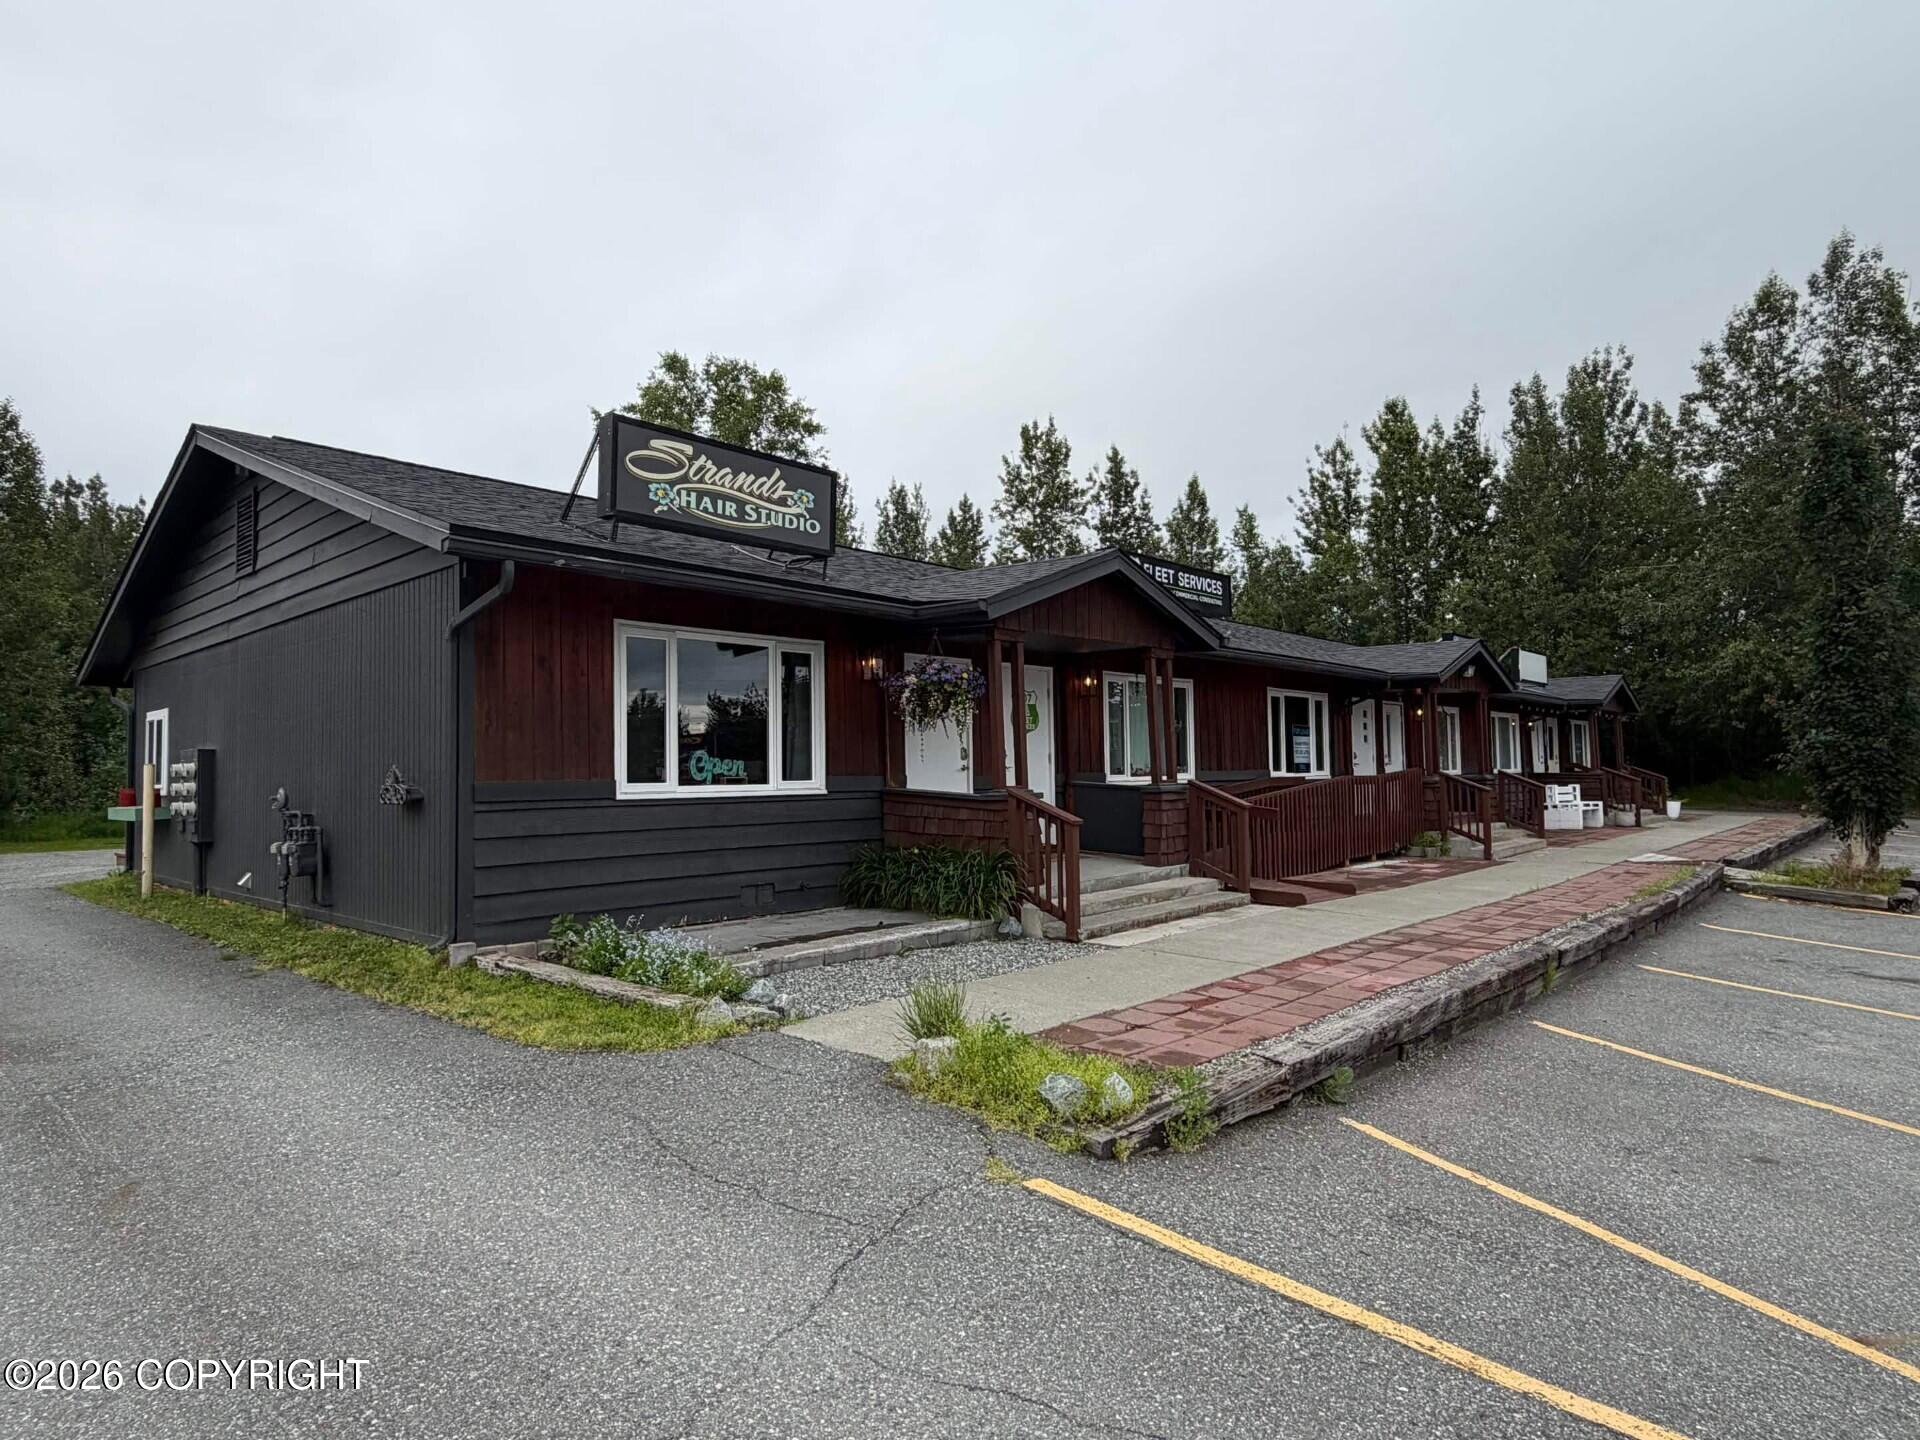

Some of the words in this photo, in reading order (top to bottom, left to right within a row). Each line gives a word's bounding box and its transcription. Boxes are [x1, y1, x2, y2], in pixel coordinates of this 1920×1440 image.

[625, 439, 796, 499] Strands
[680, 489, 739, 518] HAIR
[743, 506, 821, 535] STUDIO
[1177, 572, 1223, 595] SERVICES
